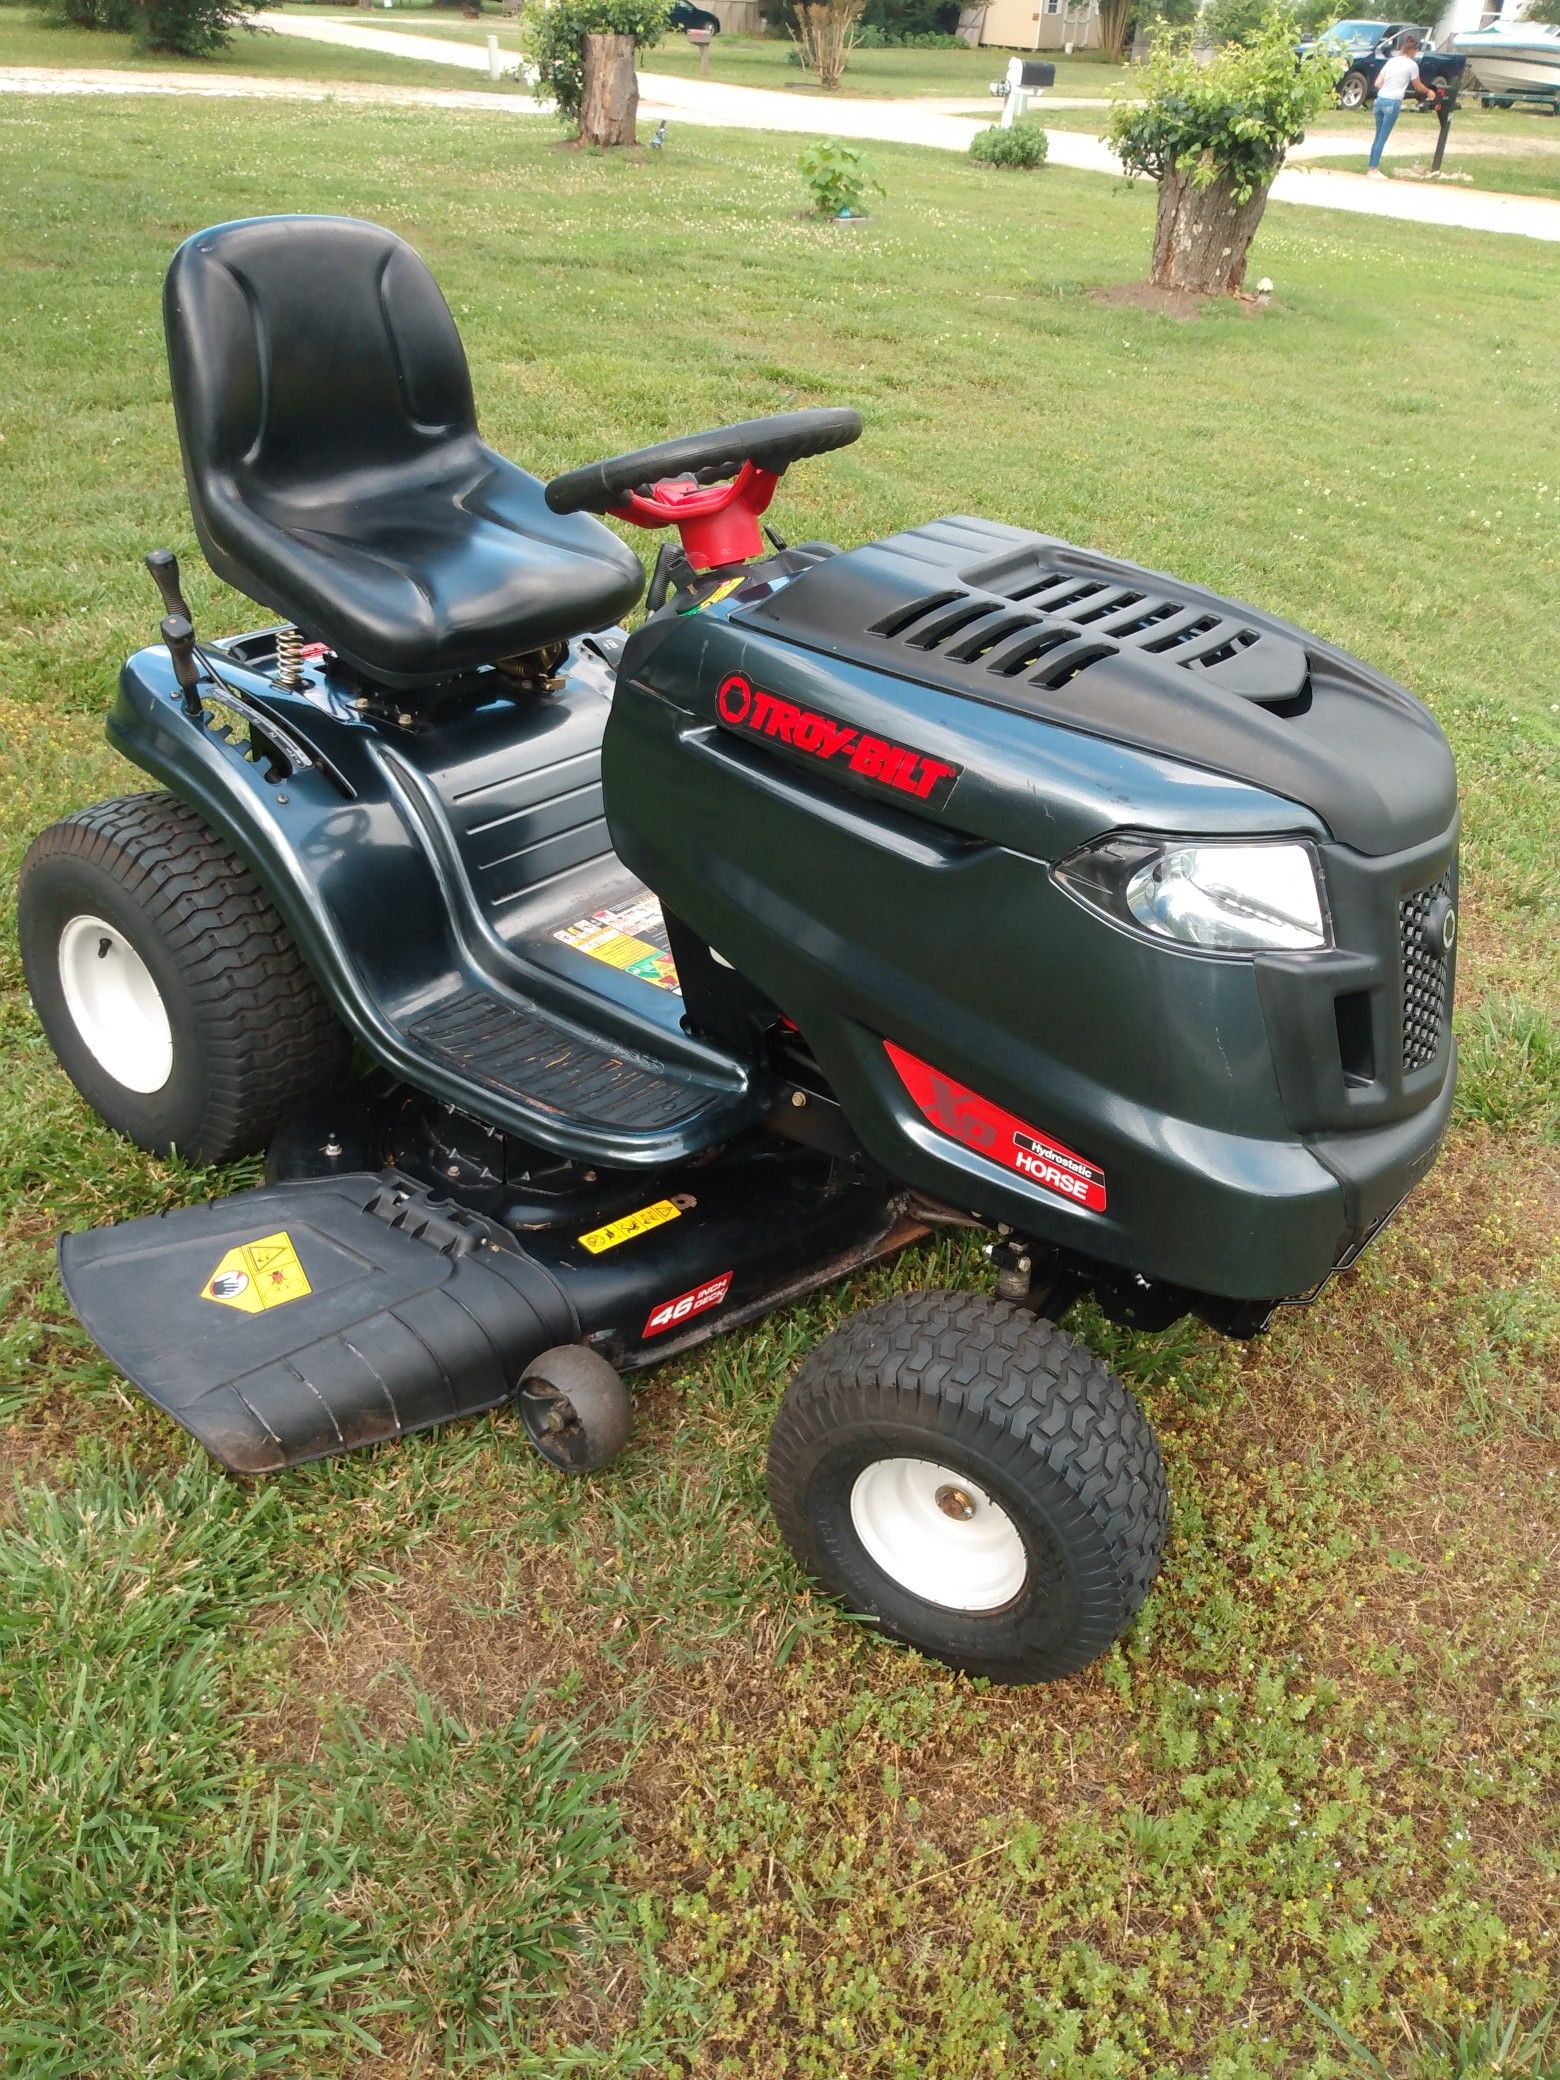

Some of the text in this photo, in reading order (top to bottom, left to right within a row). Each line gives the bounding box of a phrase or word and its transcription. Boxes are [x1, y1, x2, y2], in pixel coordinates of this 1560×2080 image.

[748, 691, 952, 799] TROY-BILT
[1015, 1152, 1089, 1201] HORSE
[1031, 1141, 1092, 1178] Hydrostatic
[650, 1278, 728, 1327] 46 INCH
[693, 1287, 726, 1310] DECK
